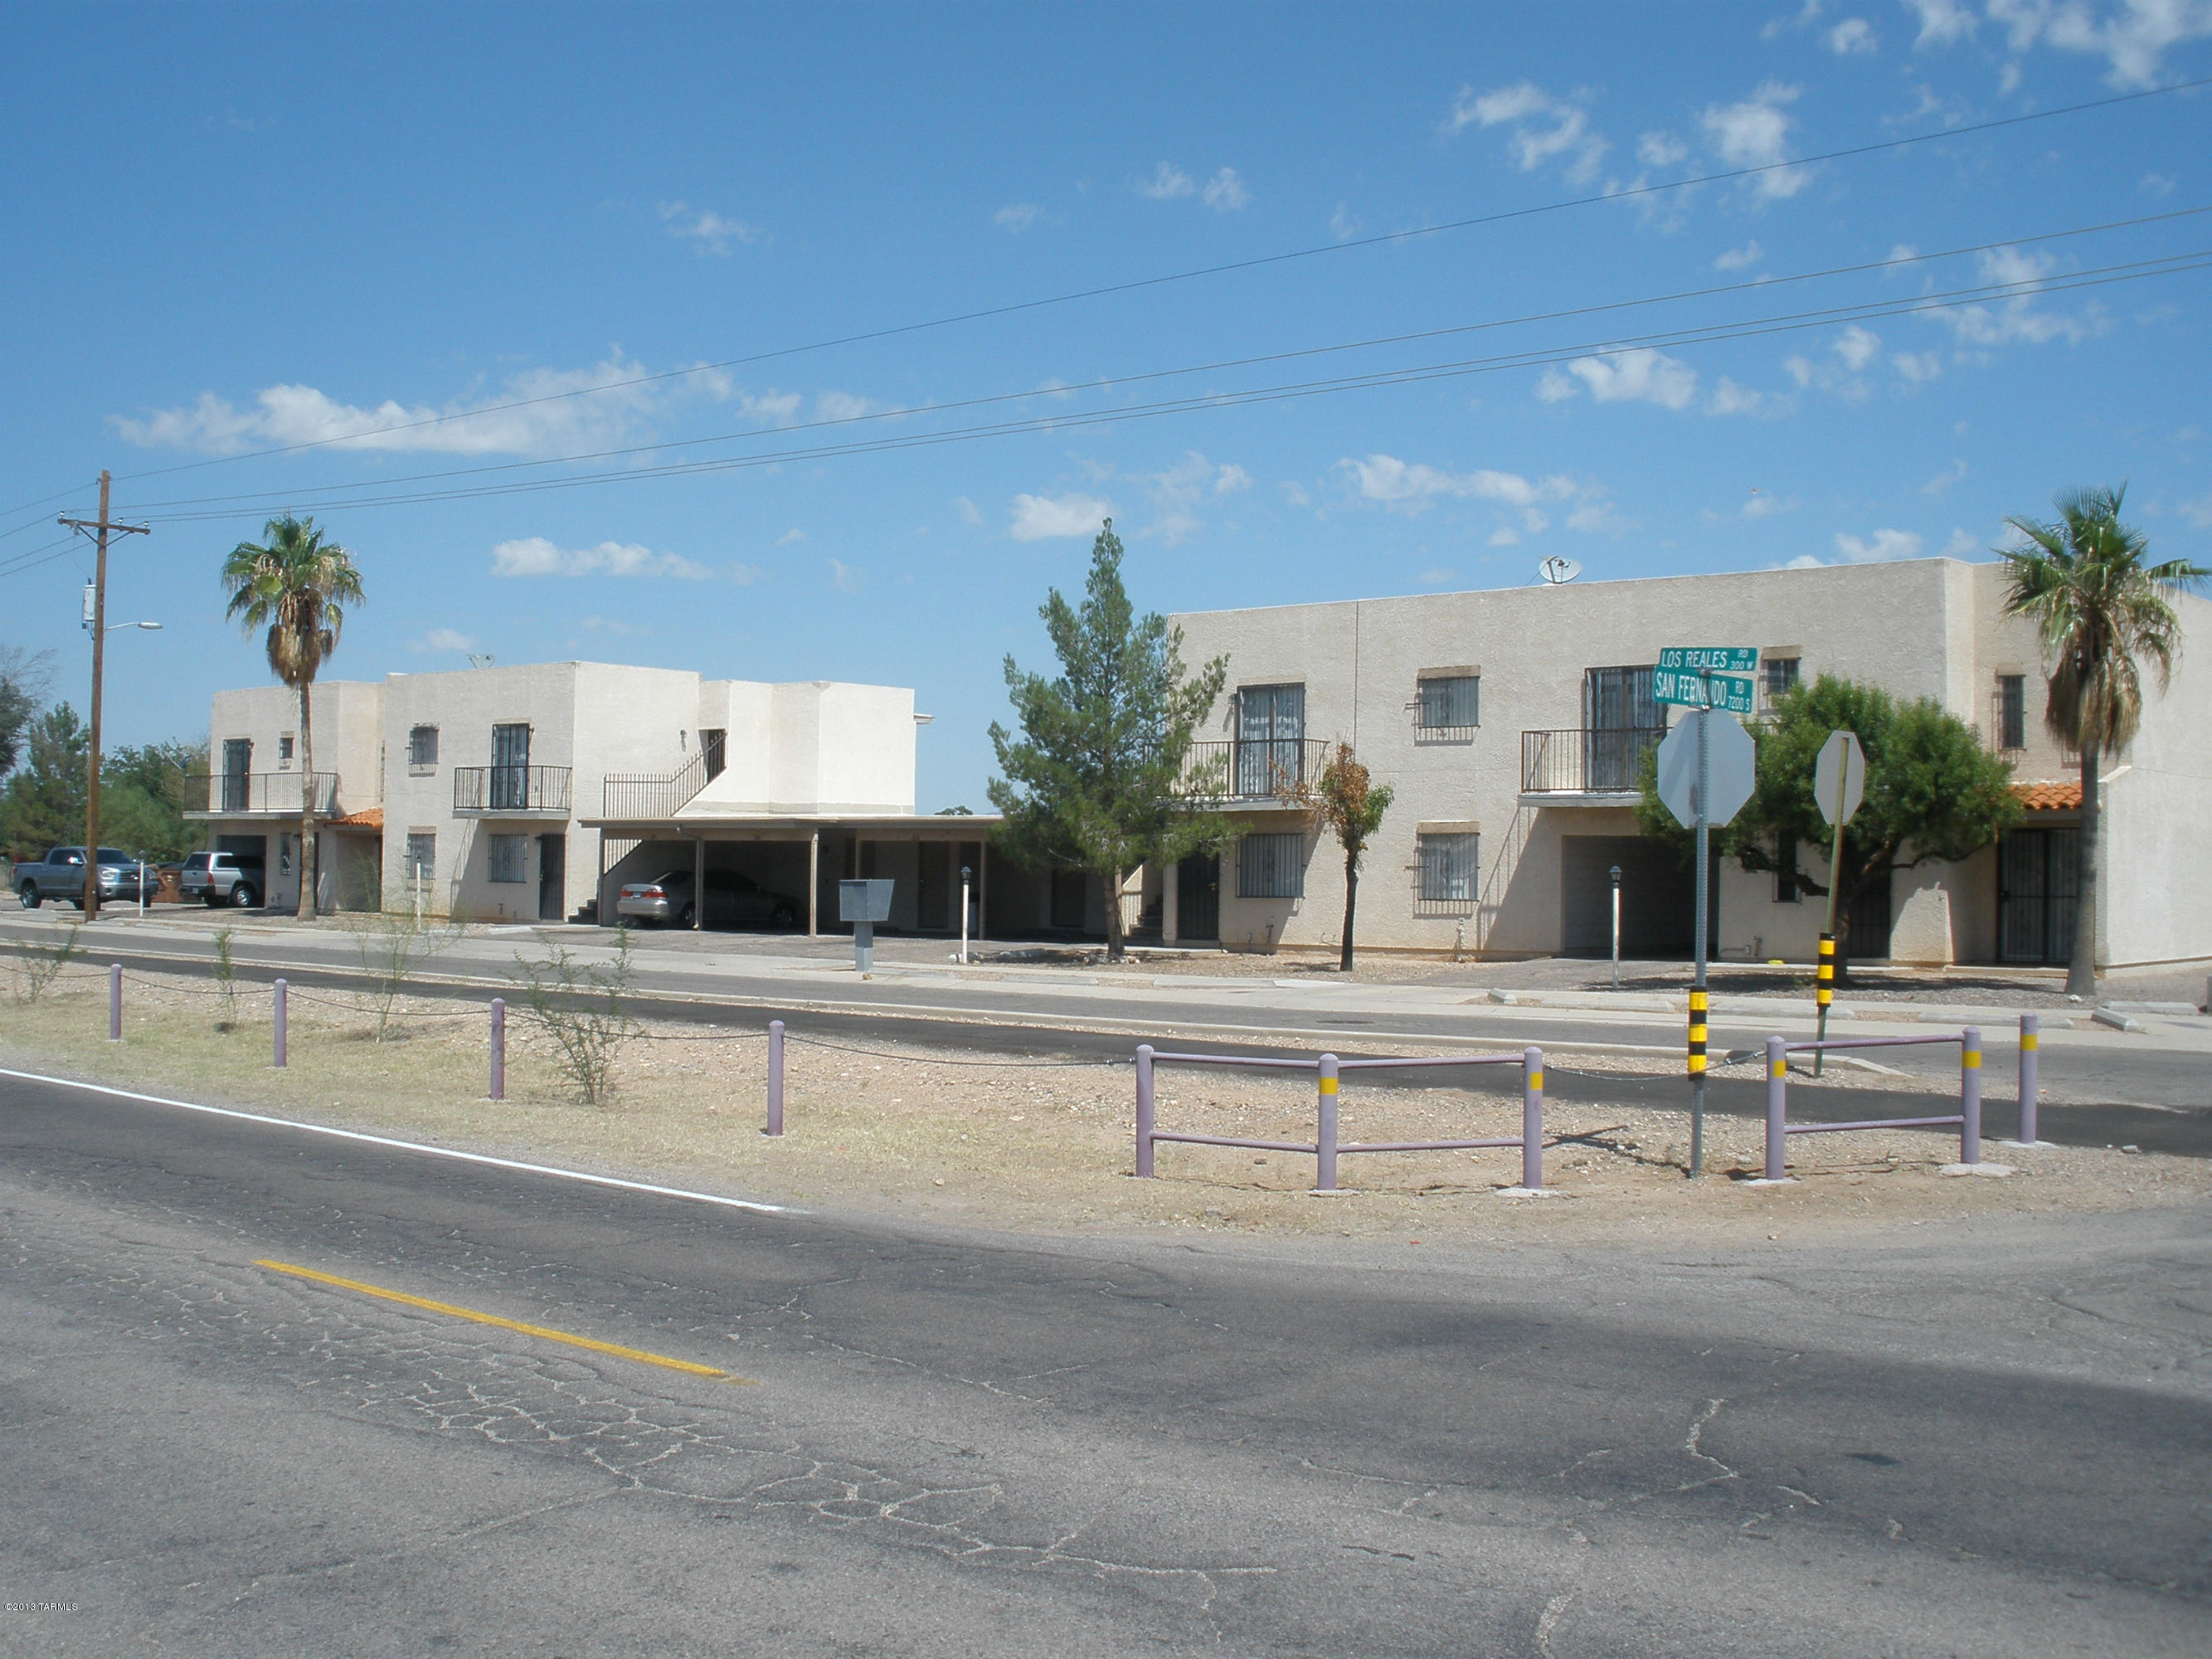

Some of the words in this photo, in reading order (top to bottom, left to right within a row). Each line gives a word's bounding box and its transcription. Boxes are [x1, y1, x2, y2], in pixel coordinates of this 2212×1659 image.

[1661, 651, 1682, 667] LOS
[1685, 651, 1728, 668] REALES
[1738, 649, 1748, 659] RD
[1730, 661, 1744, 670] 300
[1747, 661, 1754, 670] W
[1655, 672, 1675, 699] SAN
[1735, 681, 1744, 694] RD
[1728, 696, 1744, 710] 7200
[1746, 698, 1751, 711] S
